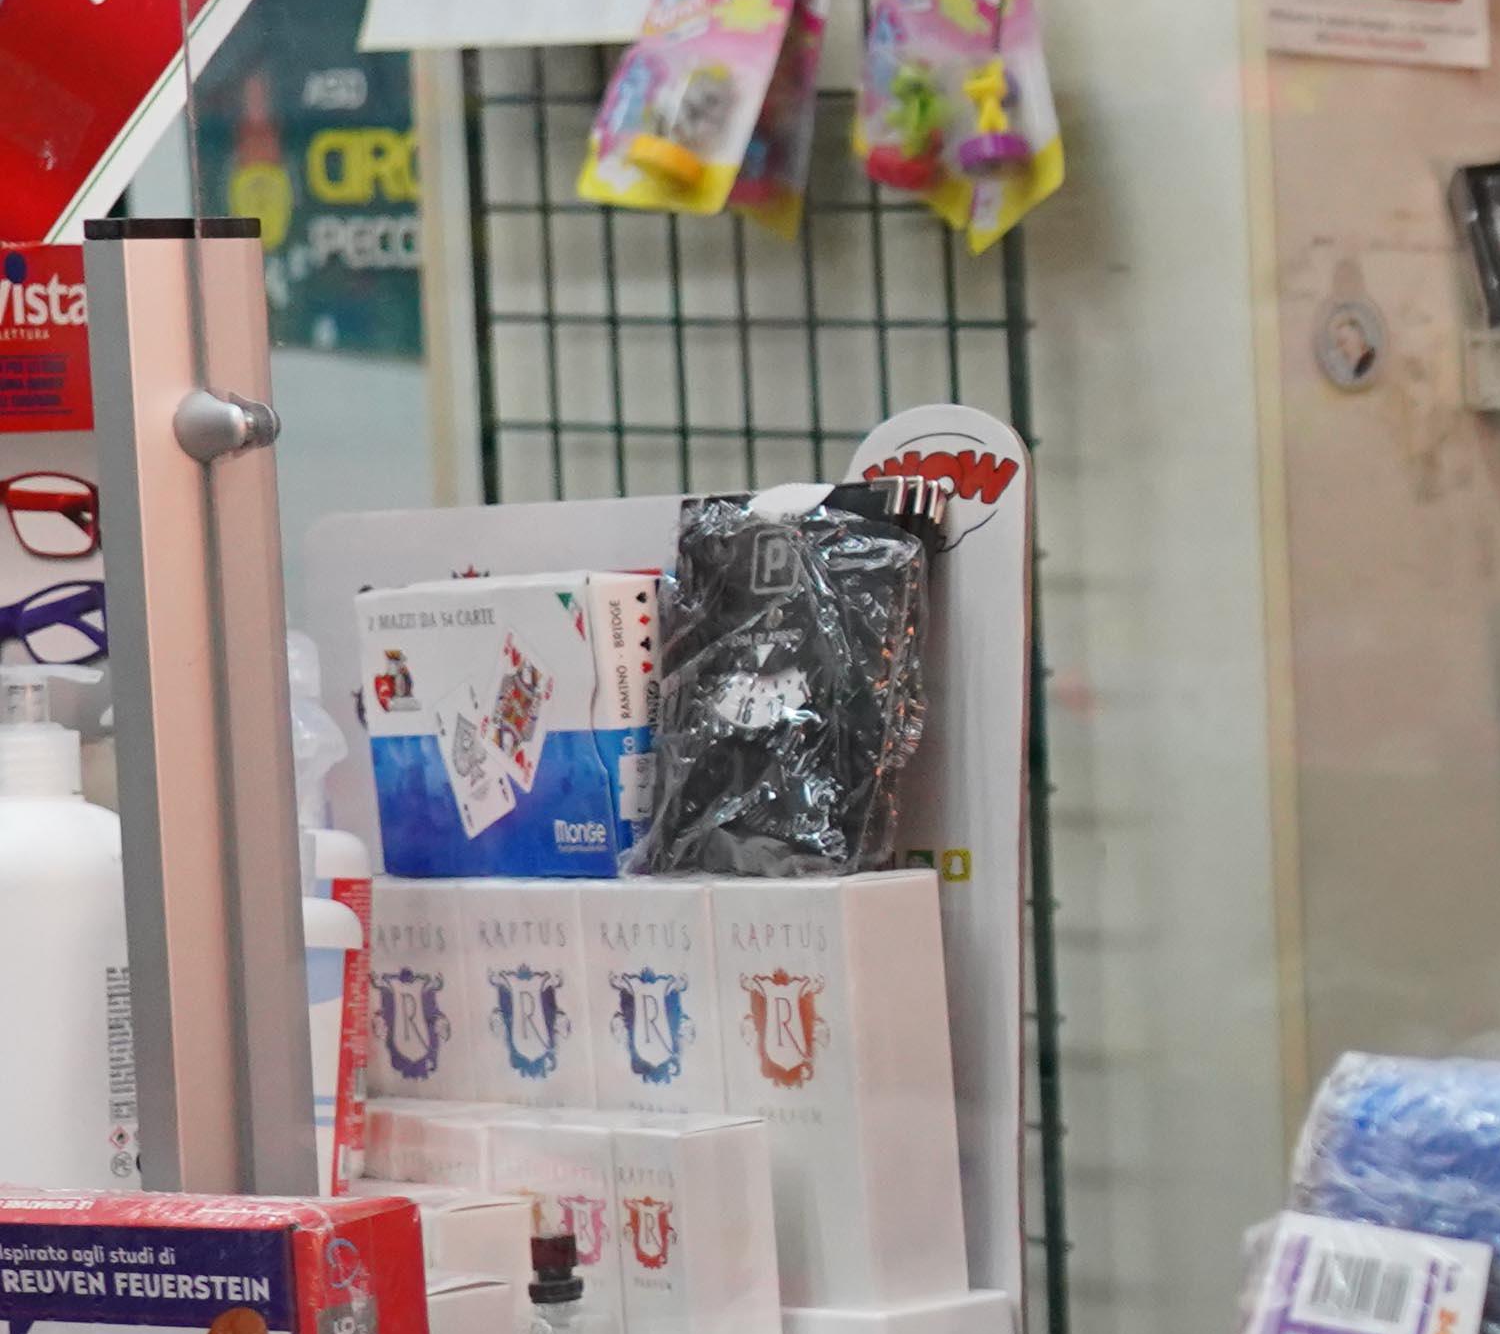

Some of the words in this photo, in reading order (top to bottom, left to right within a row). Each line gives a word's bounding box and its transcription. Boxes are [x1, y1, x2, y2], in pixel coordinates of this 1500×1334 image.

[862, 449, 1020, 505] WOW
[378, 610, 418, 631] MAZZI
[456, 607, 496, 627] CARTE
[611, 599, 624, 649] BRIDGE
[619, 668, 633, 720] RAMINO
[478, 920, 569, 949] RAPTUS
[600, 922, 693, 953] RAPTUS
[731, 922, 829, 953] RAPTUS
[72, 1247, 105, 1269] agli
[109, 1246, 154, 1265] studi
[158, 1247, 176, 1265] di
[3, 1271, 105, 1296] REUVEN
[114, 1274, 271, 1301] FEUERSTEIN
